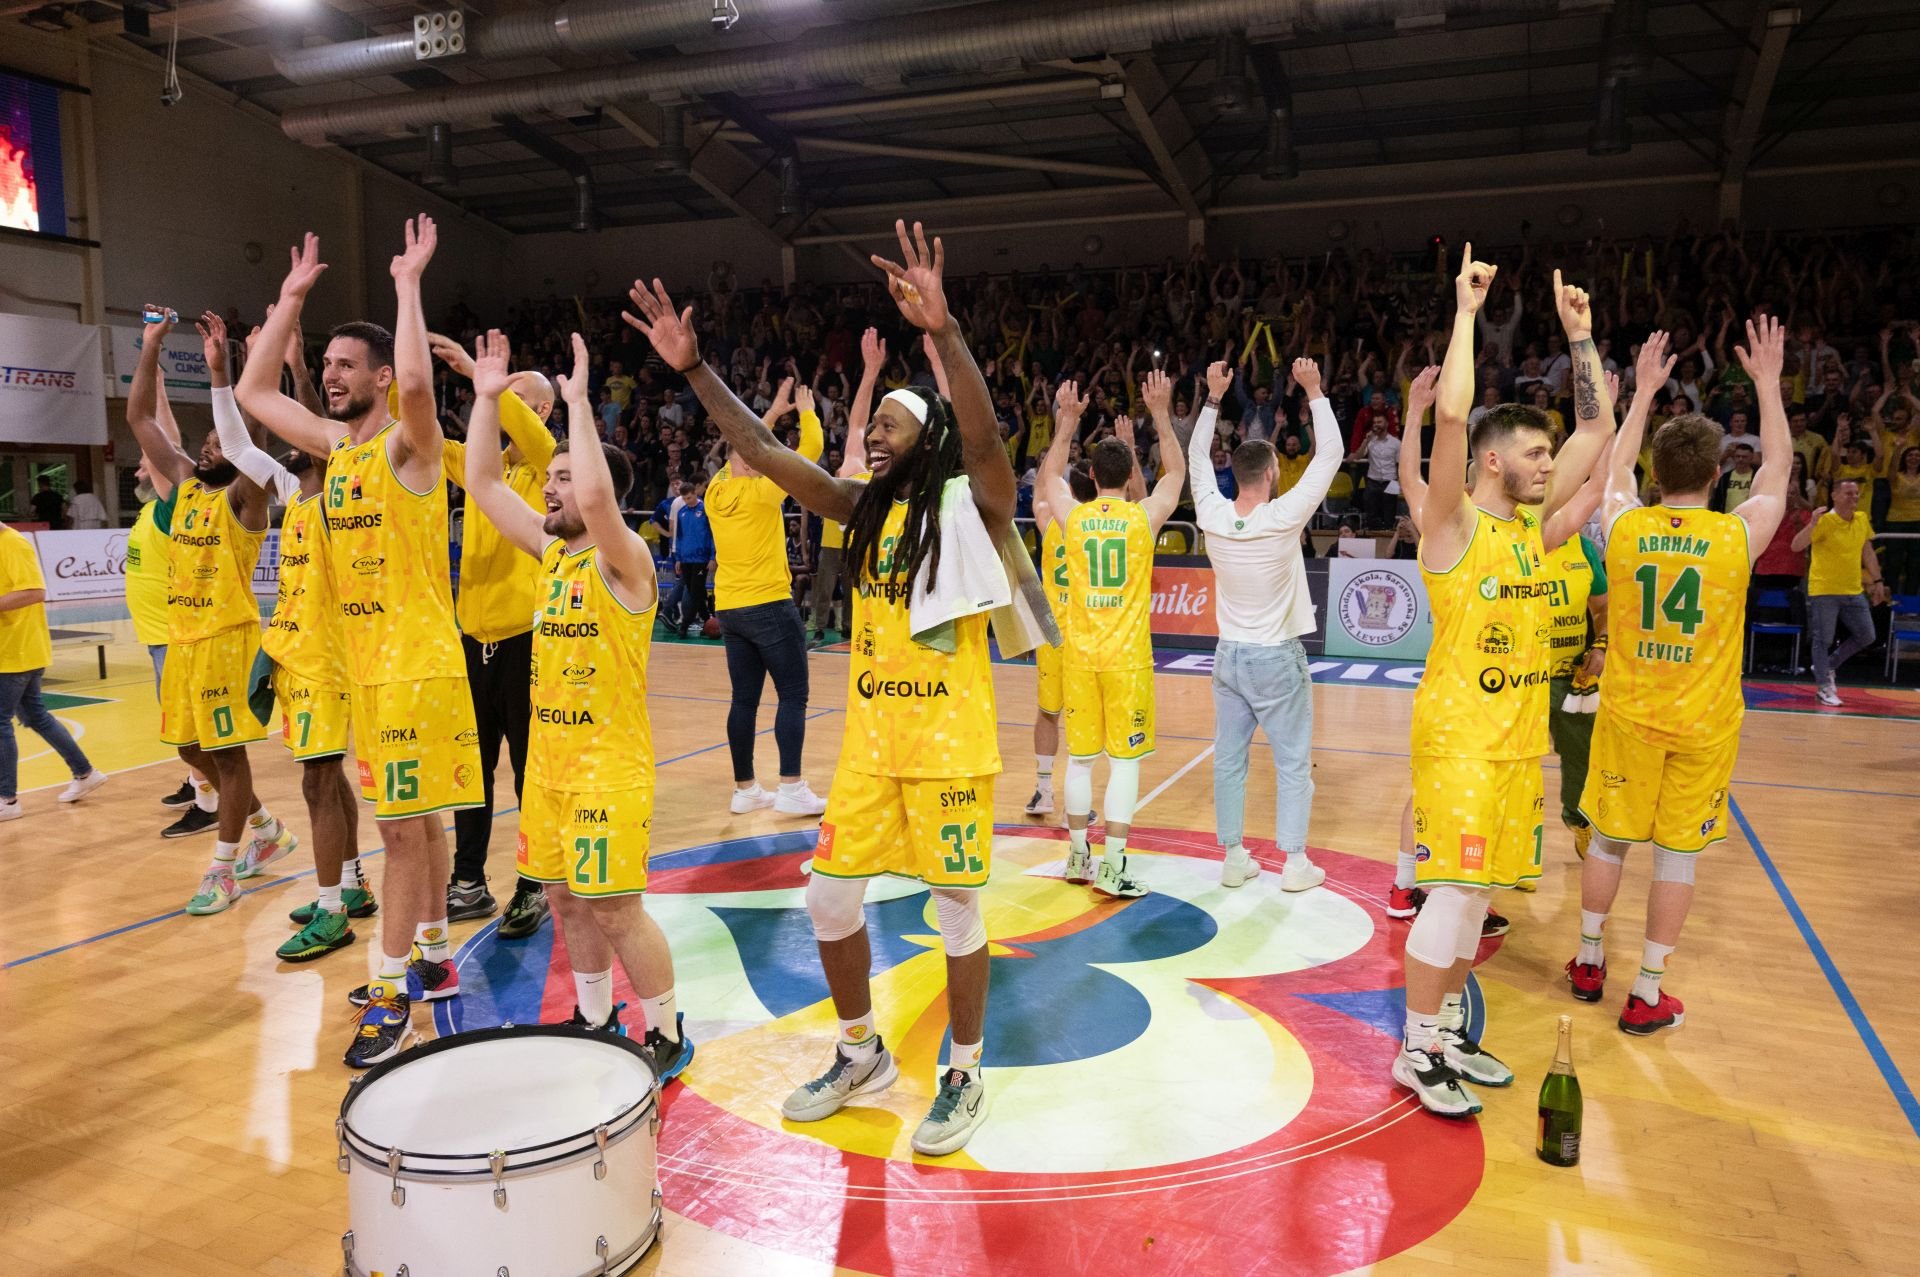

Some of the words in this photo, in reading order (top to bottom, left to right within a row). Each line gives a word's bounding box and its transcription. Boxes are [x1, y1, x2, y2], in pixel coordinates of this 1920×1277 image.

[168, 350, 206, 363] MEDICA
[0, 366, 77, 389] TRANS
[175, 362, 206, 375] CLINIC
[329, 476, 347, 508] 15
[1727, 480, 1751, 490] EPLA
[328, 514, 383, 531] TERAGROS
[1639, 534, 1710, 557] ABRHÁM
[55, 556, 116, 579] Central
[1084, 537, 1127, 588] 10
[341, 601, 384, 616] EOLIA
[1087, 595, 1124, 608] LEVICE
[1150, 583, 1208, 616] niké
[1635, 564, 1704, 634] 14
[1356, 631, 1396, 643] LEVICE
[1638, 640, 1693, 663] LEVICE
[201, 685, 229, 700] ÝPKA
[876, 680, 949, 698] VEOLIA
[213, 705, 234, 738] 0
[297, 711, 312, 747] 7
[381, 725, 417, 743] SÝPKA
[386, 760, 418, 802] 15
[575, 837, 608, 884] 21
